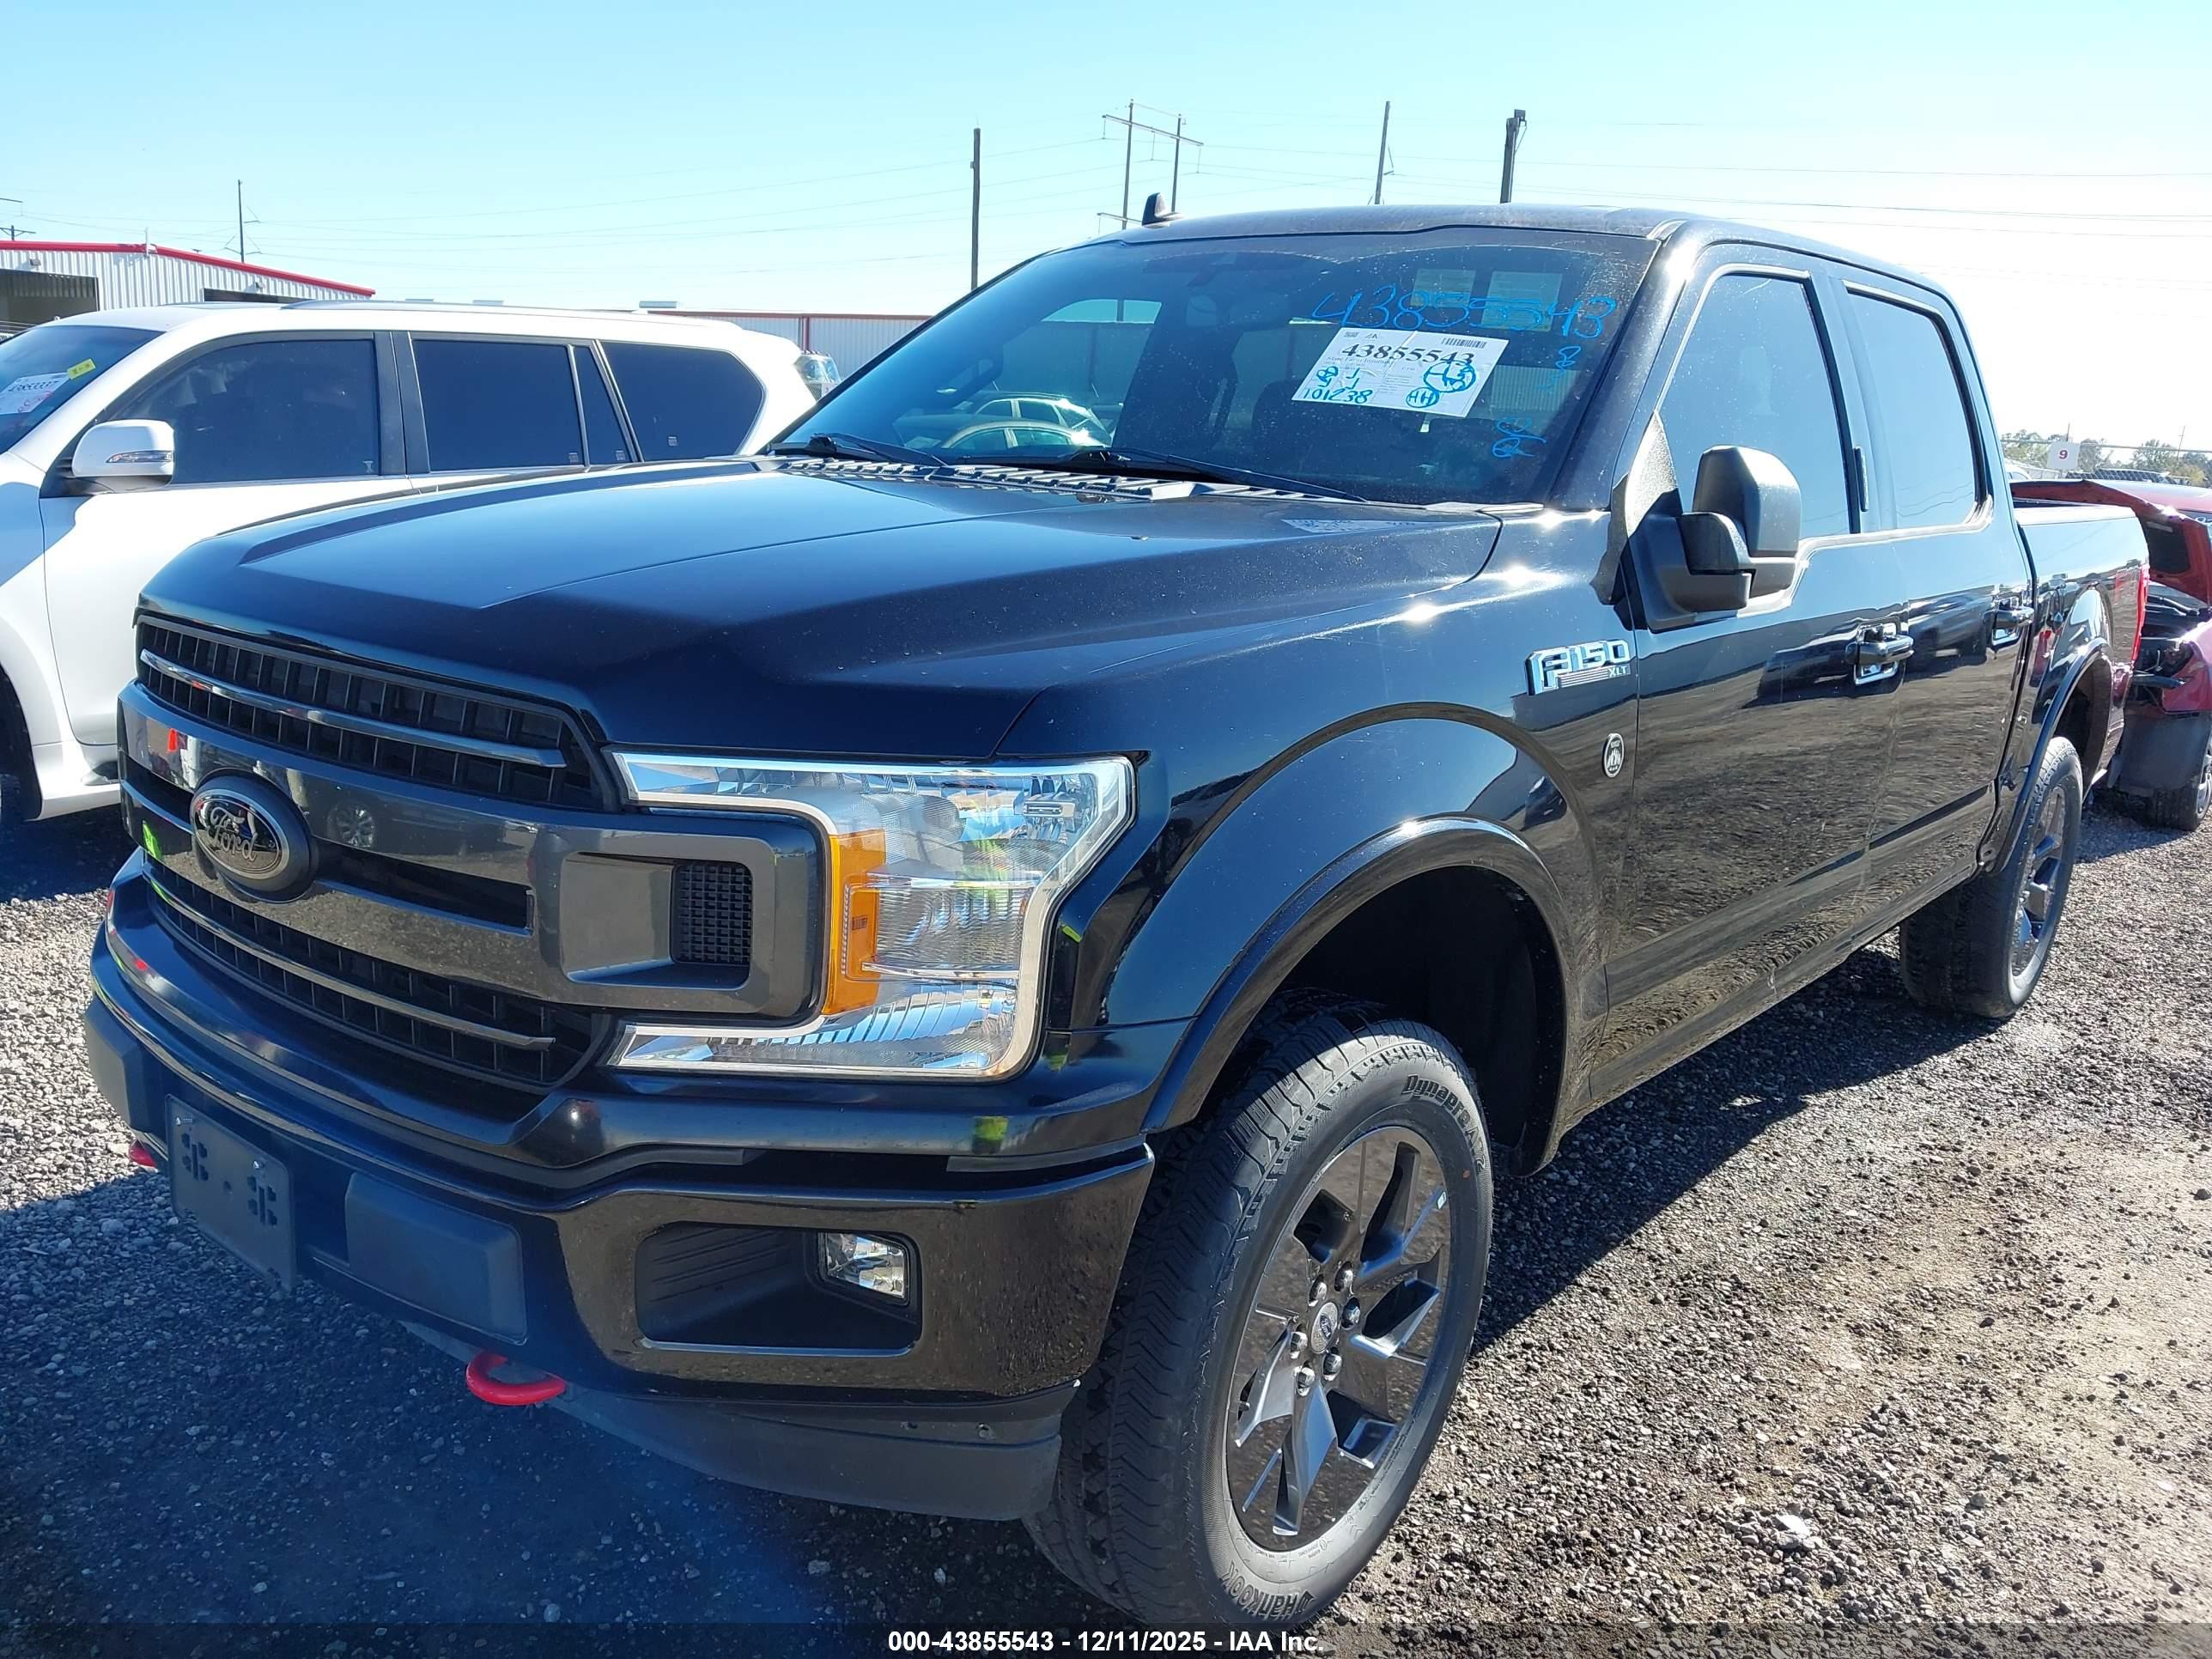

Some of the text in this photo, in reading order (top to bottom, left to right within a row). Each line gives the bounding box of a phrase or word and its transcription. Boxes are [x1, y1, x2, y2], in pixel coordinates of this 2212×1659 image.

[1311, 283, 1616, 338] 43855543
[1342, 343, 1475, 366] 43855543
[2058, 449, 2069, 460] 9
[1608, 665, 1628, 678] XLT
[206, 806, 258, 862] Ford
[1401, 1074, 1471, 1129] Dynapro
[1221, 1559, 1299, 1621] Hankook
